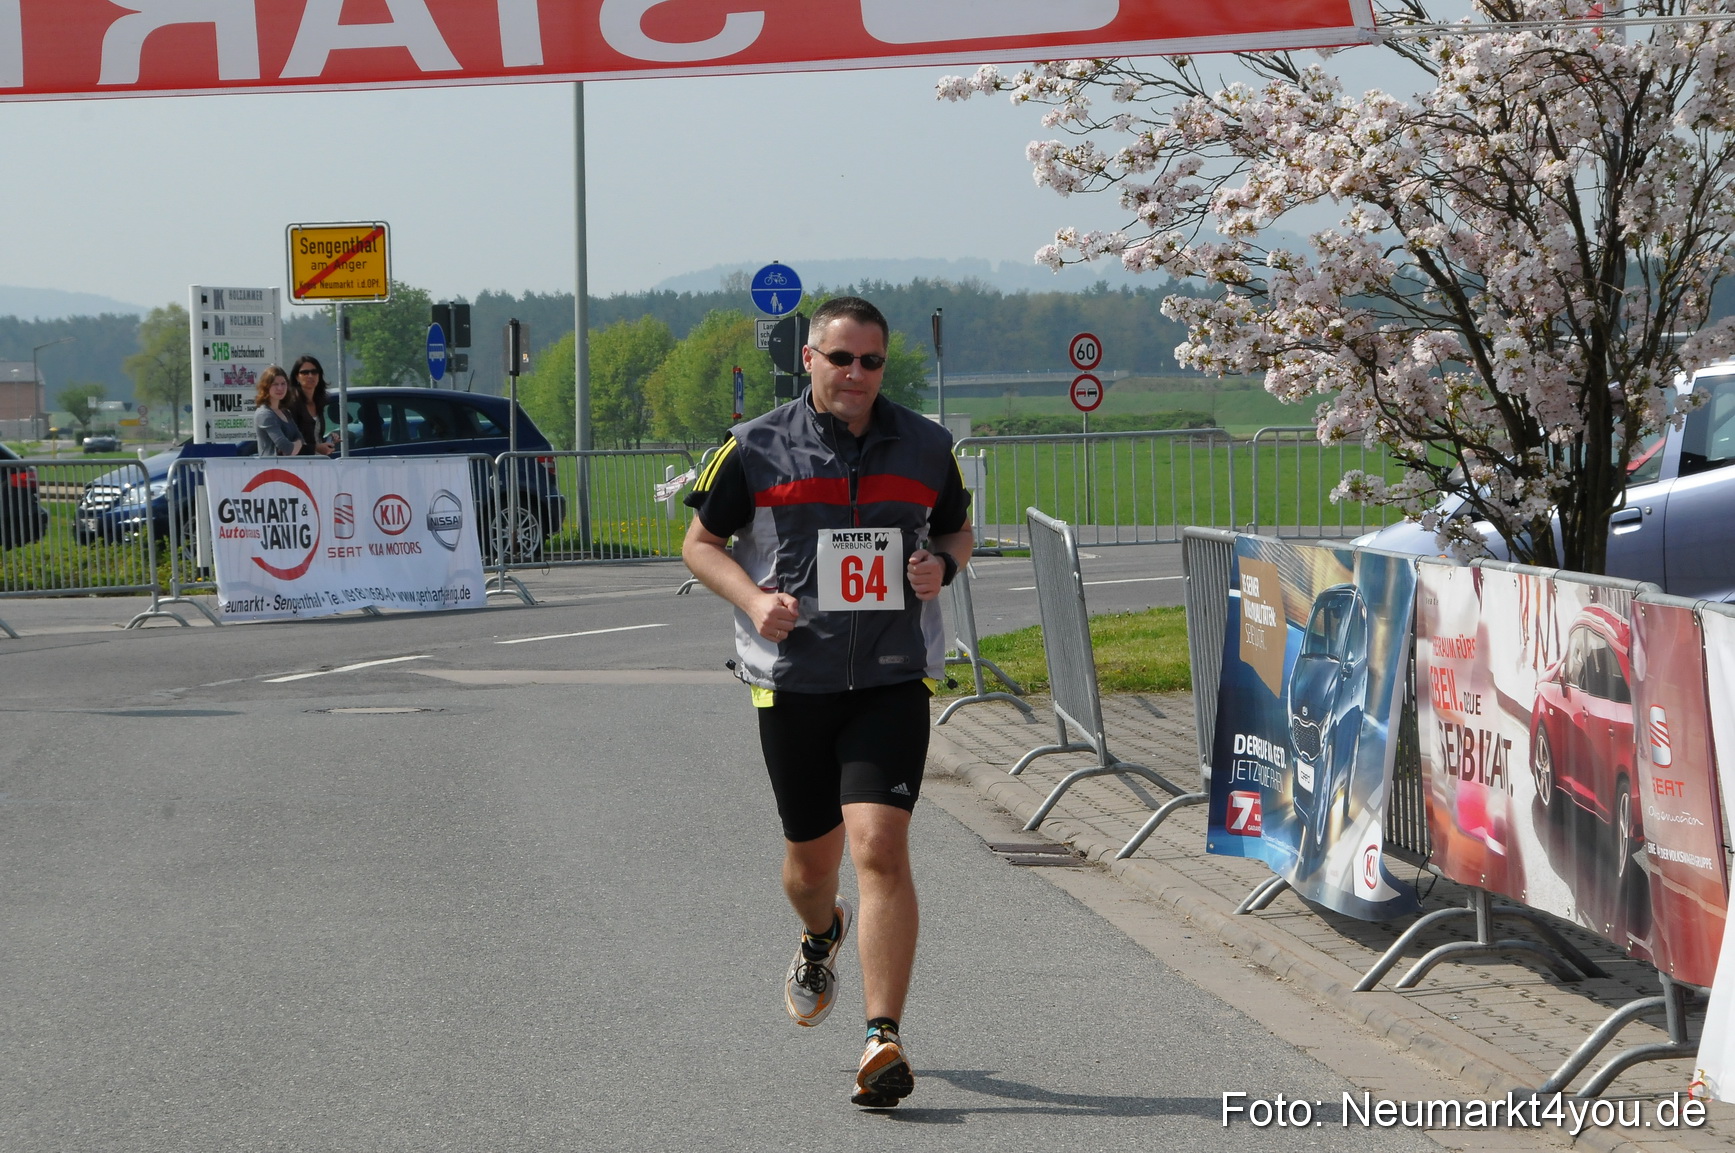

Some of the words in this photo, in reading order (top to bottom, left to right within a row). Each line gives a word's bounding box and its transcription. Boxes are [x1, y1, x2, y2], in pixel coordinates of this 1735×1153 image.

[300, 235, 377, 258] Sengenthal
[311, 262, 328, 270] am
[334, 259, 367, 272] Anger
[320, 280, 354, 289] Neumarkt
[212, 342, 231, 361] SHB
[1077, 343, 1095, 360] 60
[213, 393, 242, 412] THULE
[218, 497, 299, 523] GERHART
[301, 503, 308, 516] &
[380, 504, 406, 526] KIA
[219, 525, 260, 539] Autohaus
[260, 523, 311, 550] JÄNIG
[832, 532, 872, 542] MEYER
[327, 546, 363, 558] SEAT
[368, 543, 385, 556] KIA
[386, 541, 422, 556] MOTORS
[832, 542, 873, 550] WERBUNG
[841, 555, 888, 603] 64
[225, 594, 264, 613] eumarkt
[1231, 796, 1255, 830] 7
